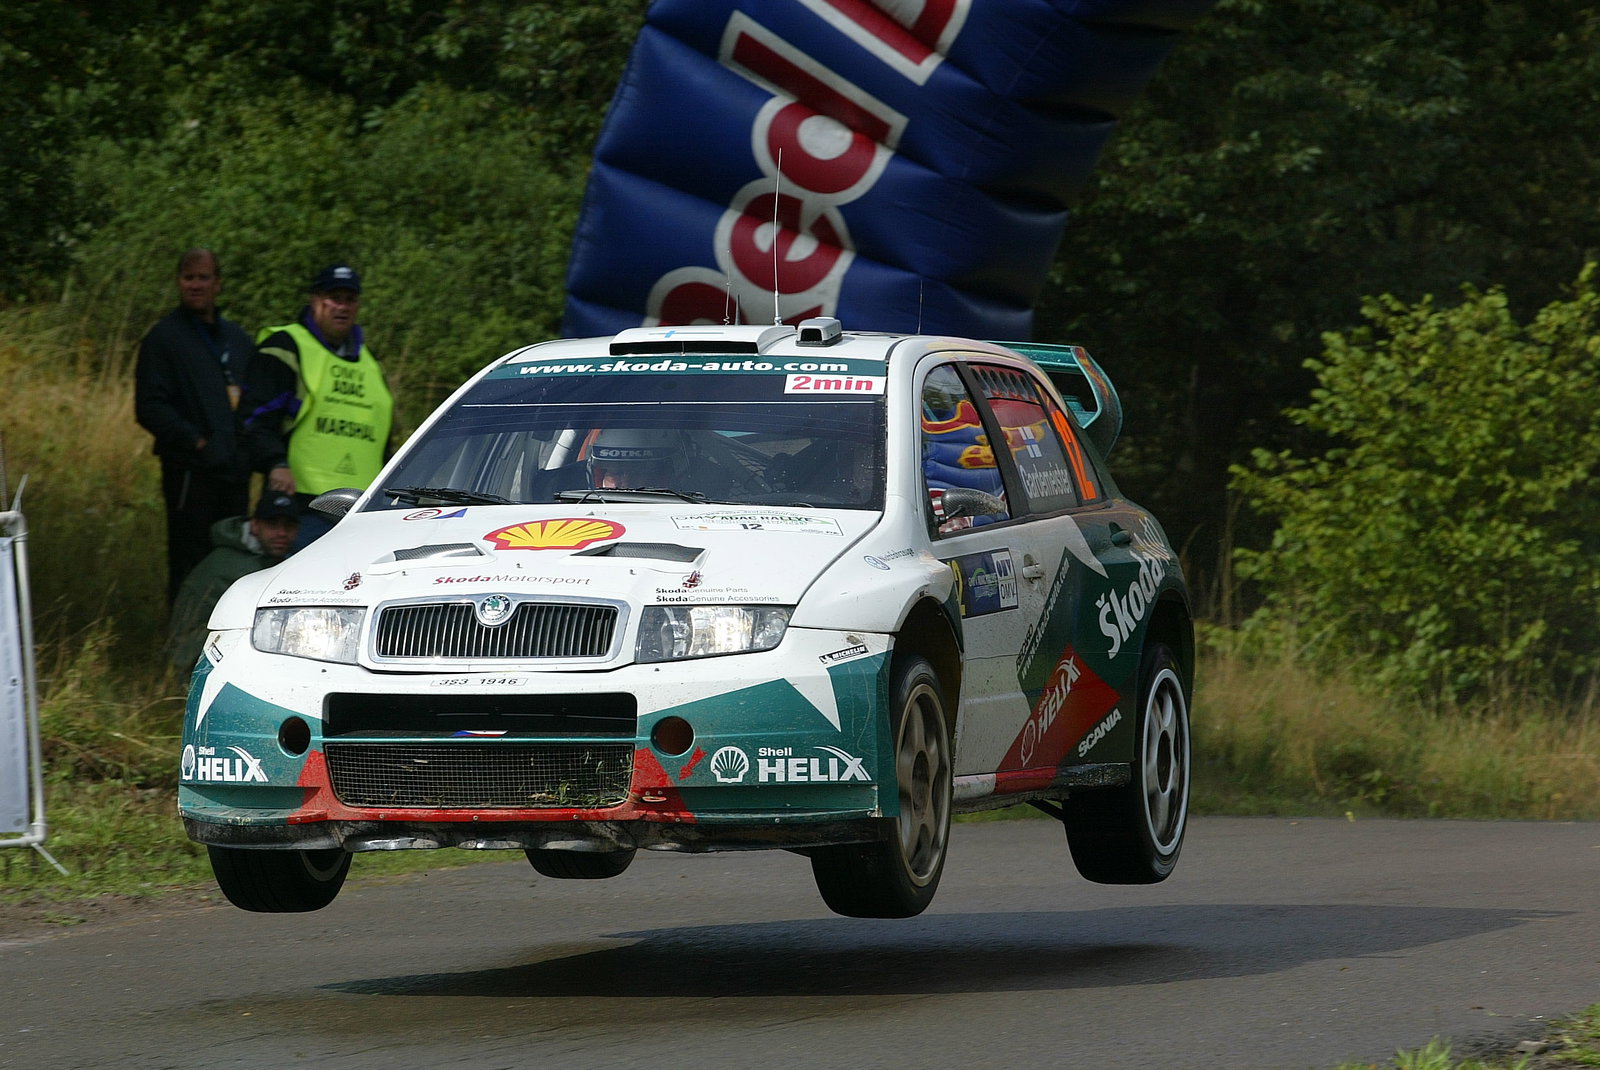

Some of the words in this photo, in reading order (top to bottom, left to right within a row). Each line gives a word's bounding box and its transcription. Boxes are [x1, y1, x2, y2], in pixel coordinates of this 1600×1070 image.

[519, 359, 849, 375] www.skoda-auto.com
[792, 375, 874, 391] 2min
[314, 417, 376, 442] MARSHAL
[740, 523, 765, 531] 12
[480, 678, 519, 686] 1946
[1038, 655, 1081, 744] HELIX
[1077, 708, 1122, 758] SCANIA
[198, 746, 215, 756] Shell
[758, 747, 792, 757] Shell
[197, 746, 269, 782] HELIX
[757, 746, 872, 782] HELIX
